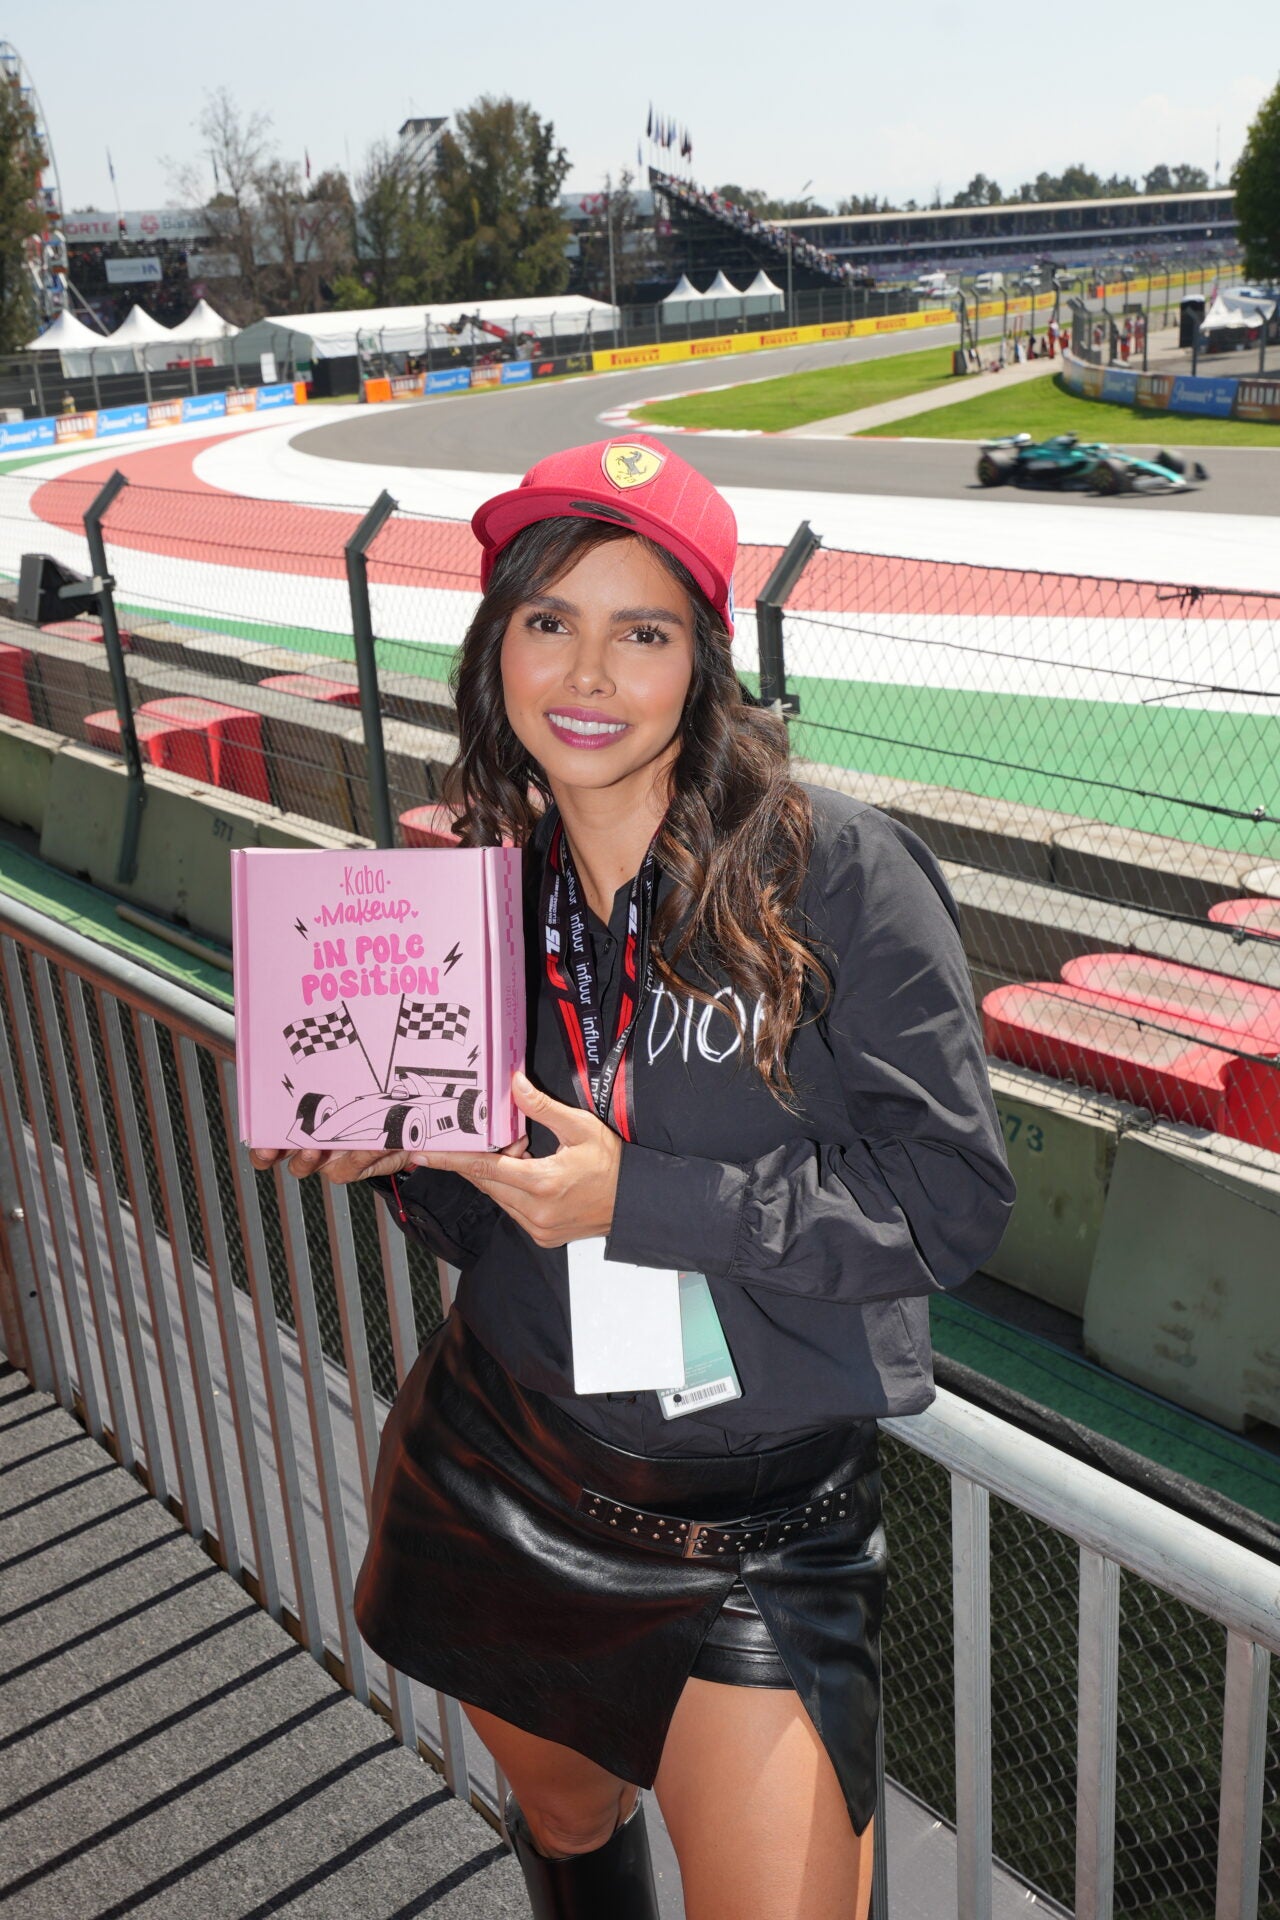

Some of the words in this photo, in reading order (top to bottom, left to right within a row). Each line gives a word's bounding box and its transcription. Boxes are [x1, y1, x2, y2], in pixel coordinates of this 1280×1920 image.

[344, 865, 385, 896] Kaba
[321, 898, 411, 927] Makeup
[570, 911, 584, 953] influur
[576, 962, 592, 1005] influur
[583, 1016, 600, 1065] influur
